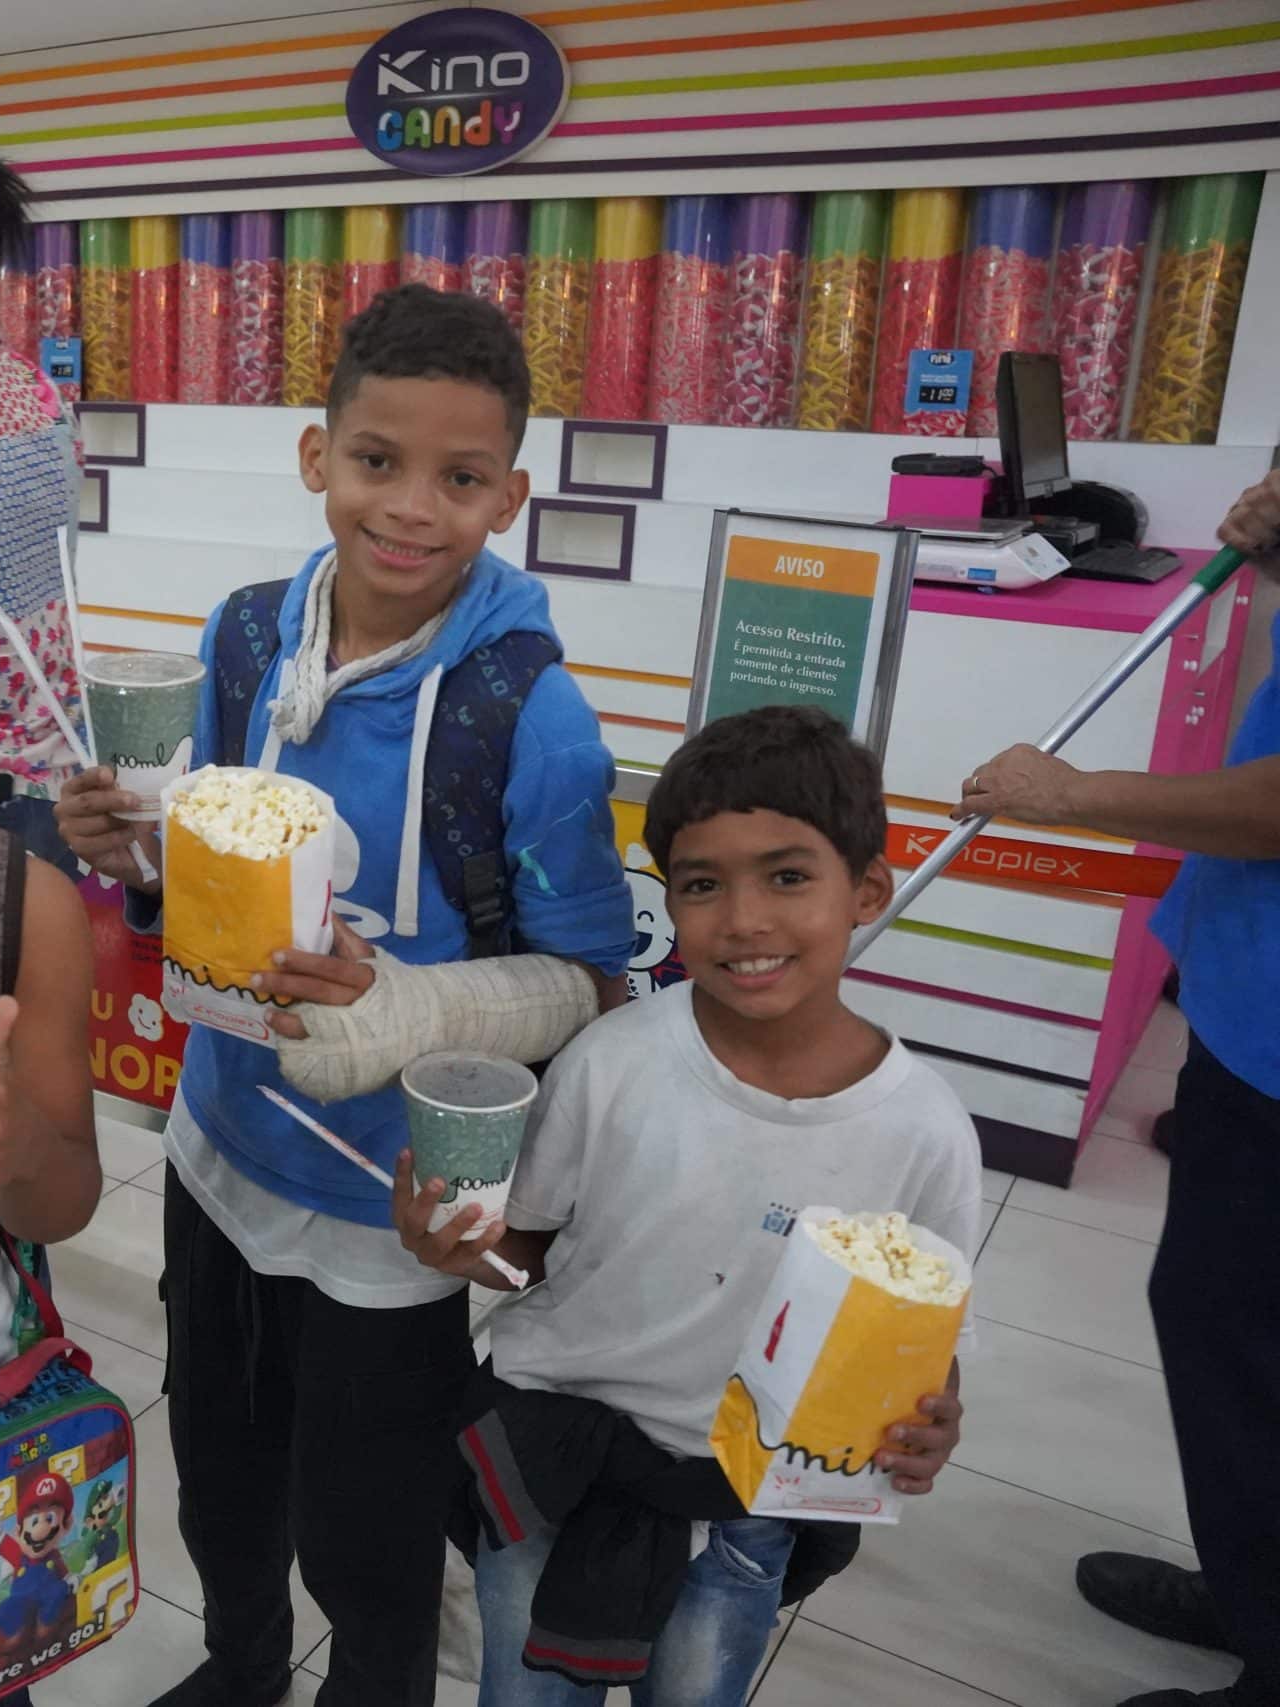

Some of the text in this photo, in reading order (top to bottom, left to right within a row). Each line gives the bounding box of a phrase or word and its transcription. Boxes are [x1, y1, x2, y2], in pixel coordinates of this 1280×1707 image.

[376, 49, 530, 95] Kino
[775, 555, 825, 579] AVISO
[735, 619, 846, 649] Acesso Restrito.
[734, 638, 846, 669] É permitida a entrada
[734, 656, 838, 682] somente de clientes
[729, 670, 837, 697] portando o ingresso.
[30, 1641, 63, 1667] we
